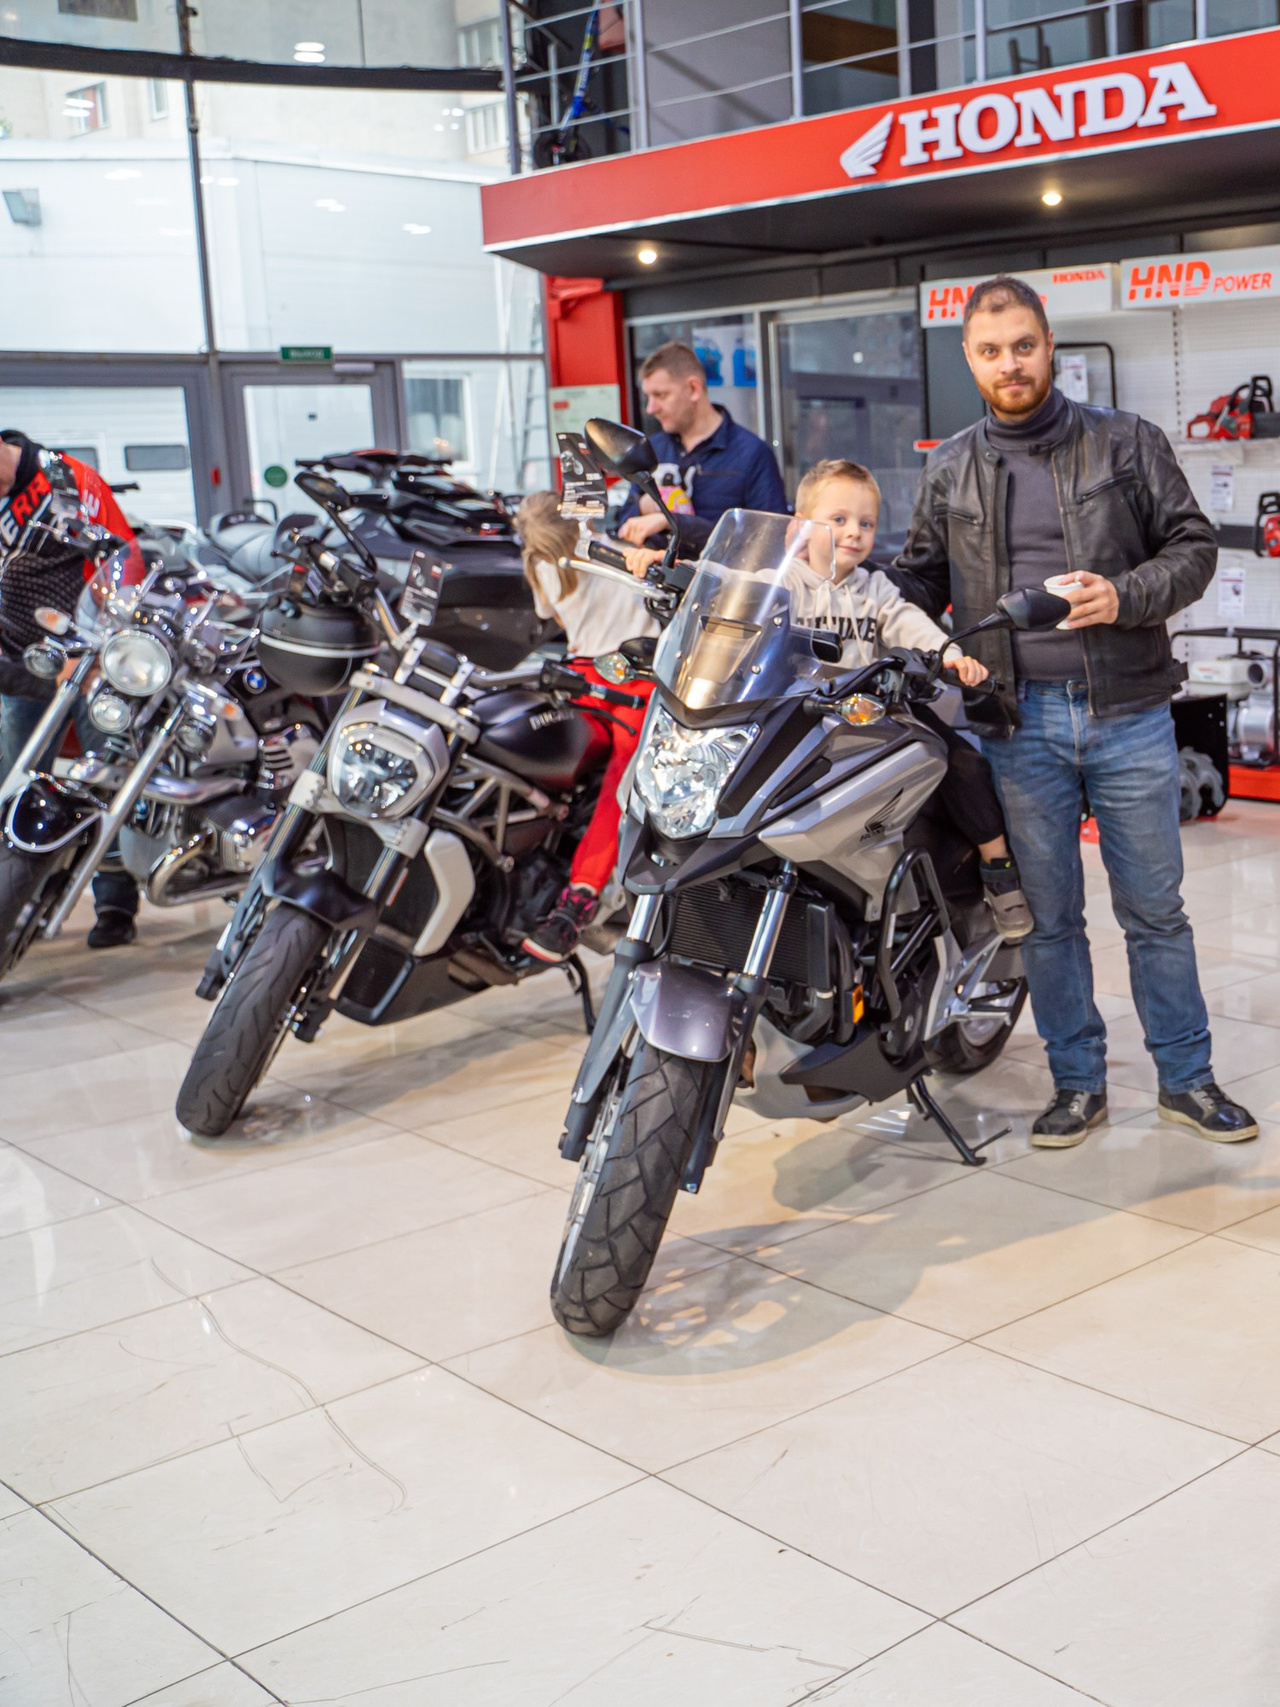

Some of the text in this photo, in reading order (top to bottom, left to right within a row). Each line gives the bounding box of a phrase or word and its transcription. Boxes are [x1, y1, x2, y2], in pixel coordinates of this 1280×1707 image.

[899, 62, 1217, 166] HONDA
[1053, 269, 1106, 284] HONDA
[1128, 260, 1272, 300] HND POWER
[928, 285, 975, 320] HN
